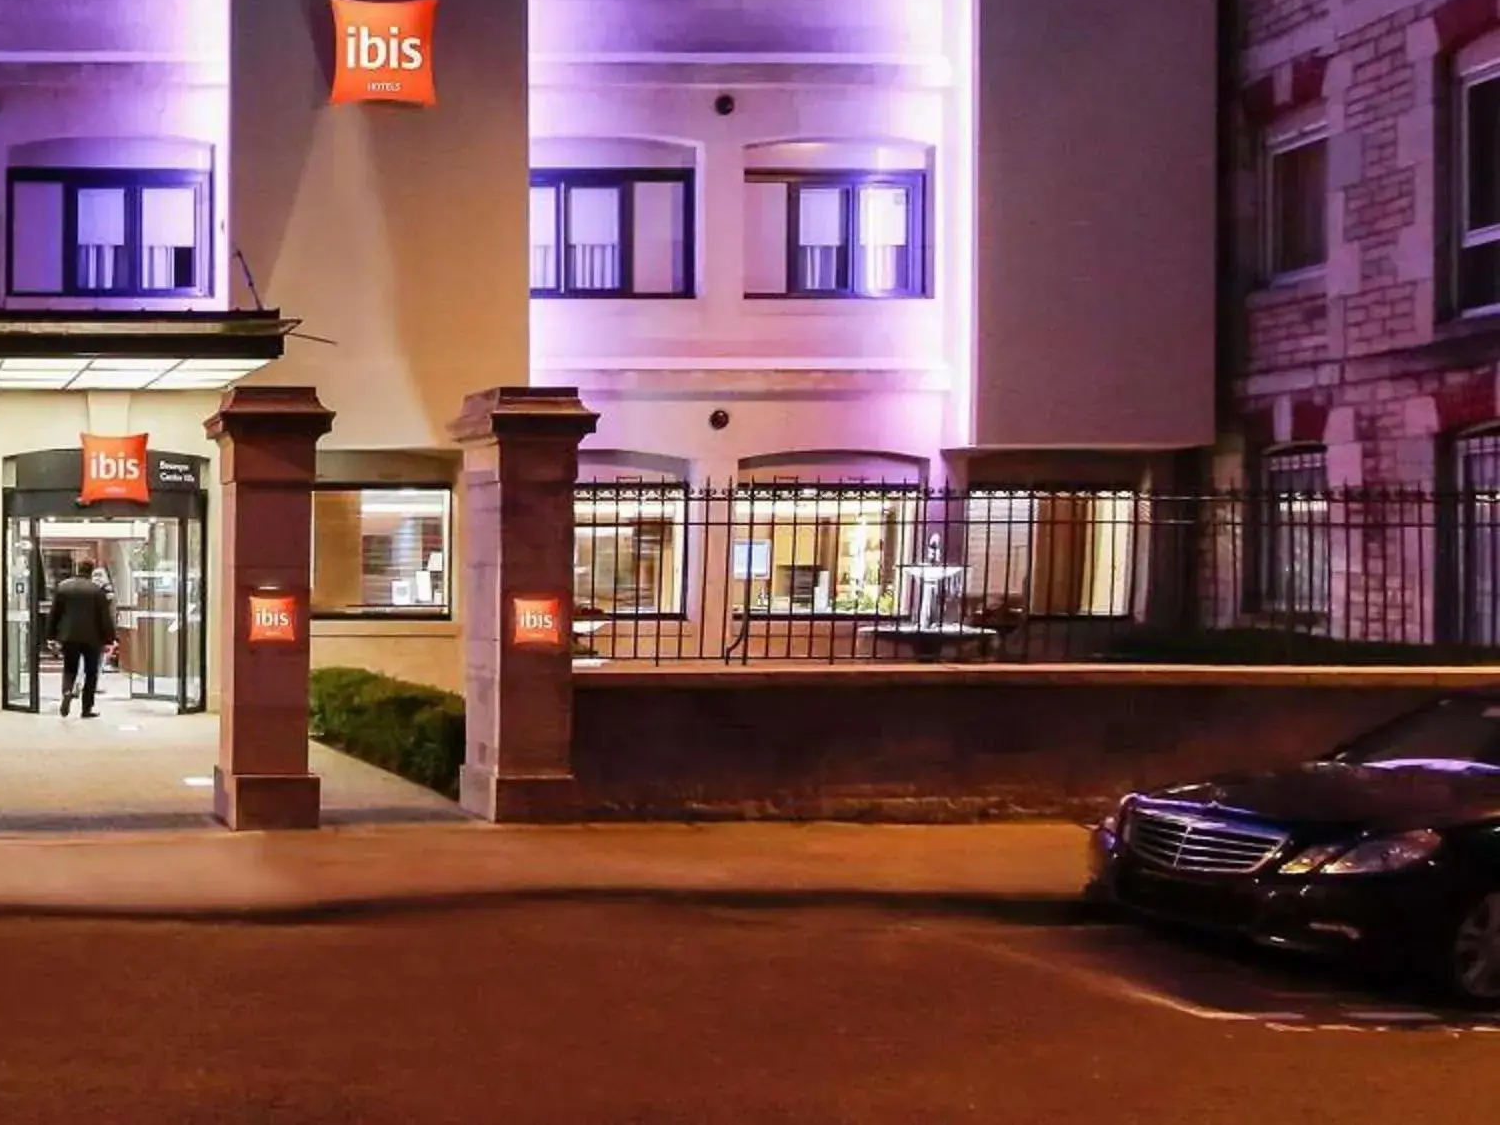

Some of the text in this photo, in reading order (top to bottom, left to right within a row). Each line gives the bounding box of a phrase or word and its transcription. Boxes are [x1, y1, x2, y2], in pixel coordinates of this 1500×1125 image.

[346, 26, 423, 70] ibis
[90, 451, 140, 480] ibis
[255, 607, 289, 626] ibis
[520, 610, 553, 629] ibis
